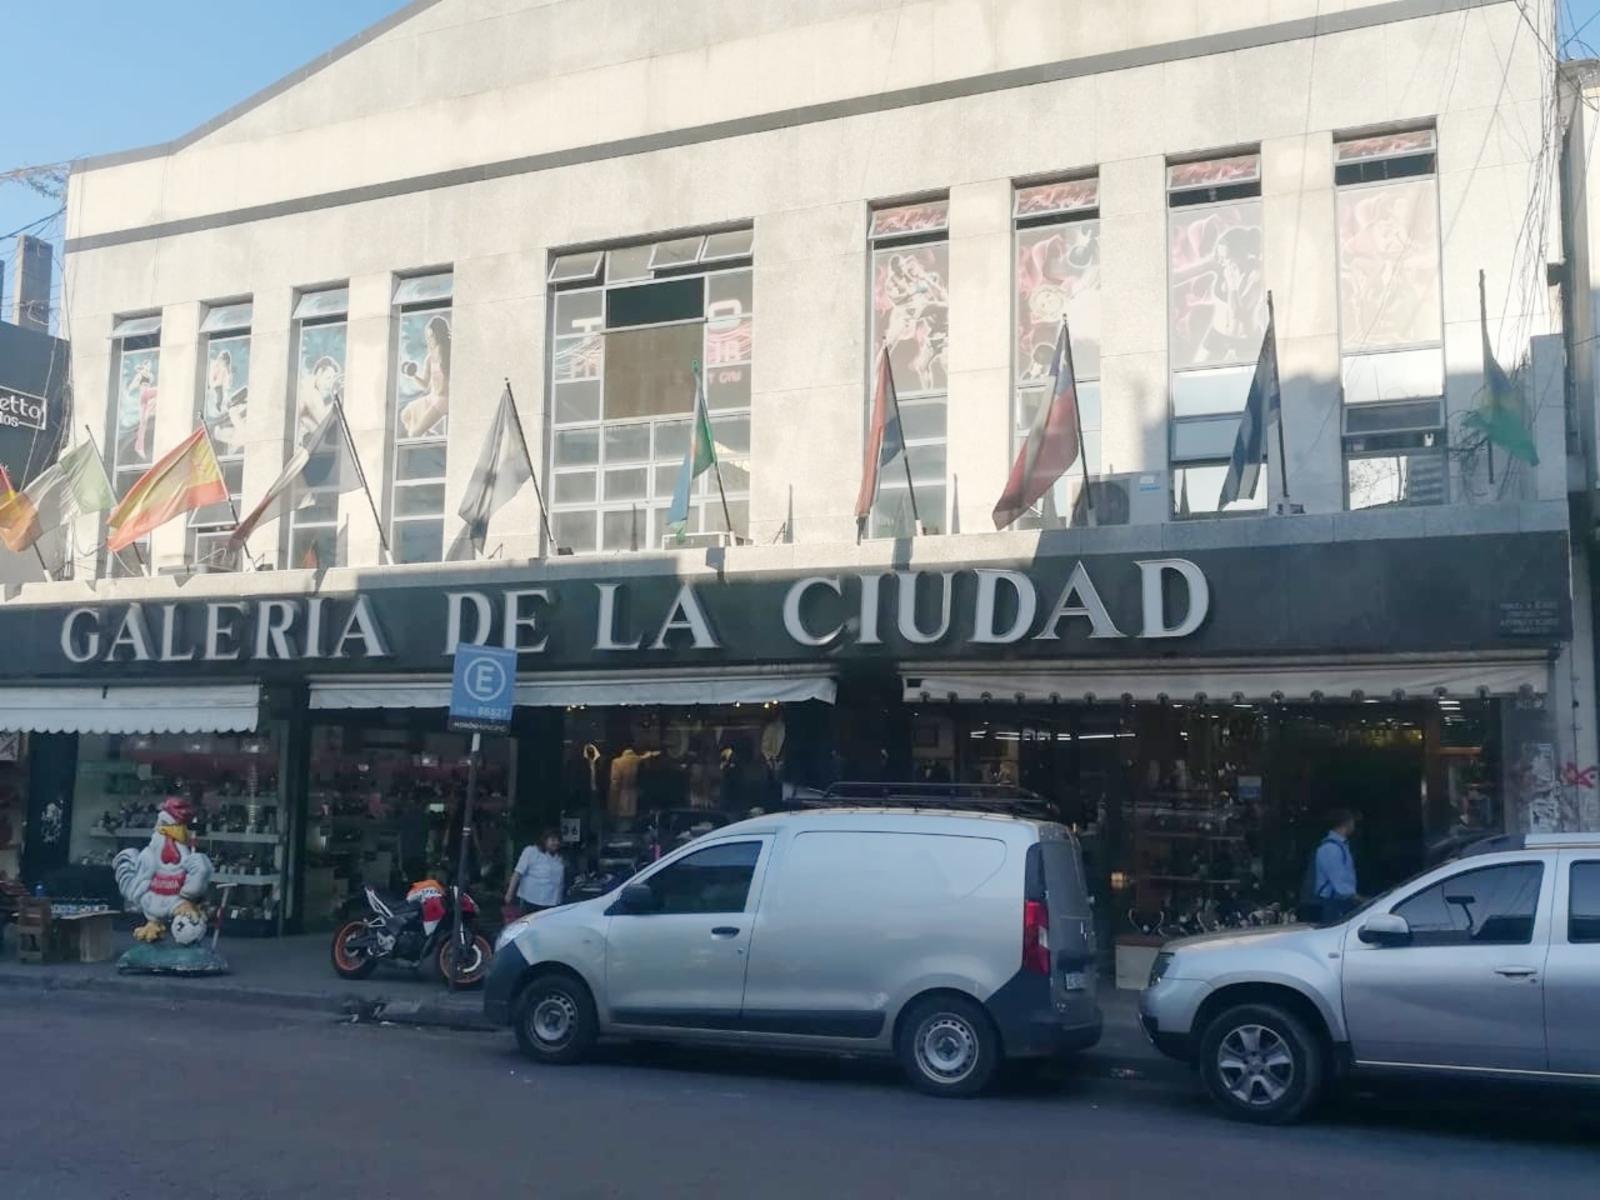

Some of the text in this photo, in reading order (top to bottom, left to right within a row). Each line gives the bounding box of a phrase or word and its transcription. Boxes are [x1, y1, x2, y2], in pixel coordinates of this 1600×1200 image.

[60, 558, 1211, 663] GALERIA DE LA CIUDAD
